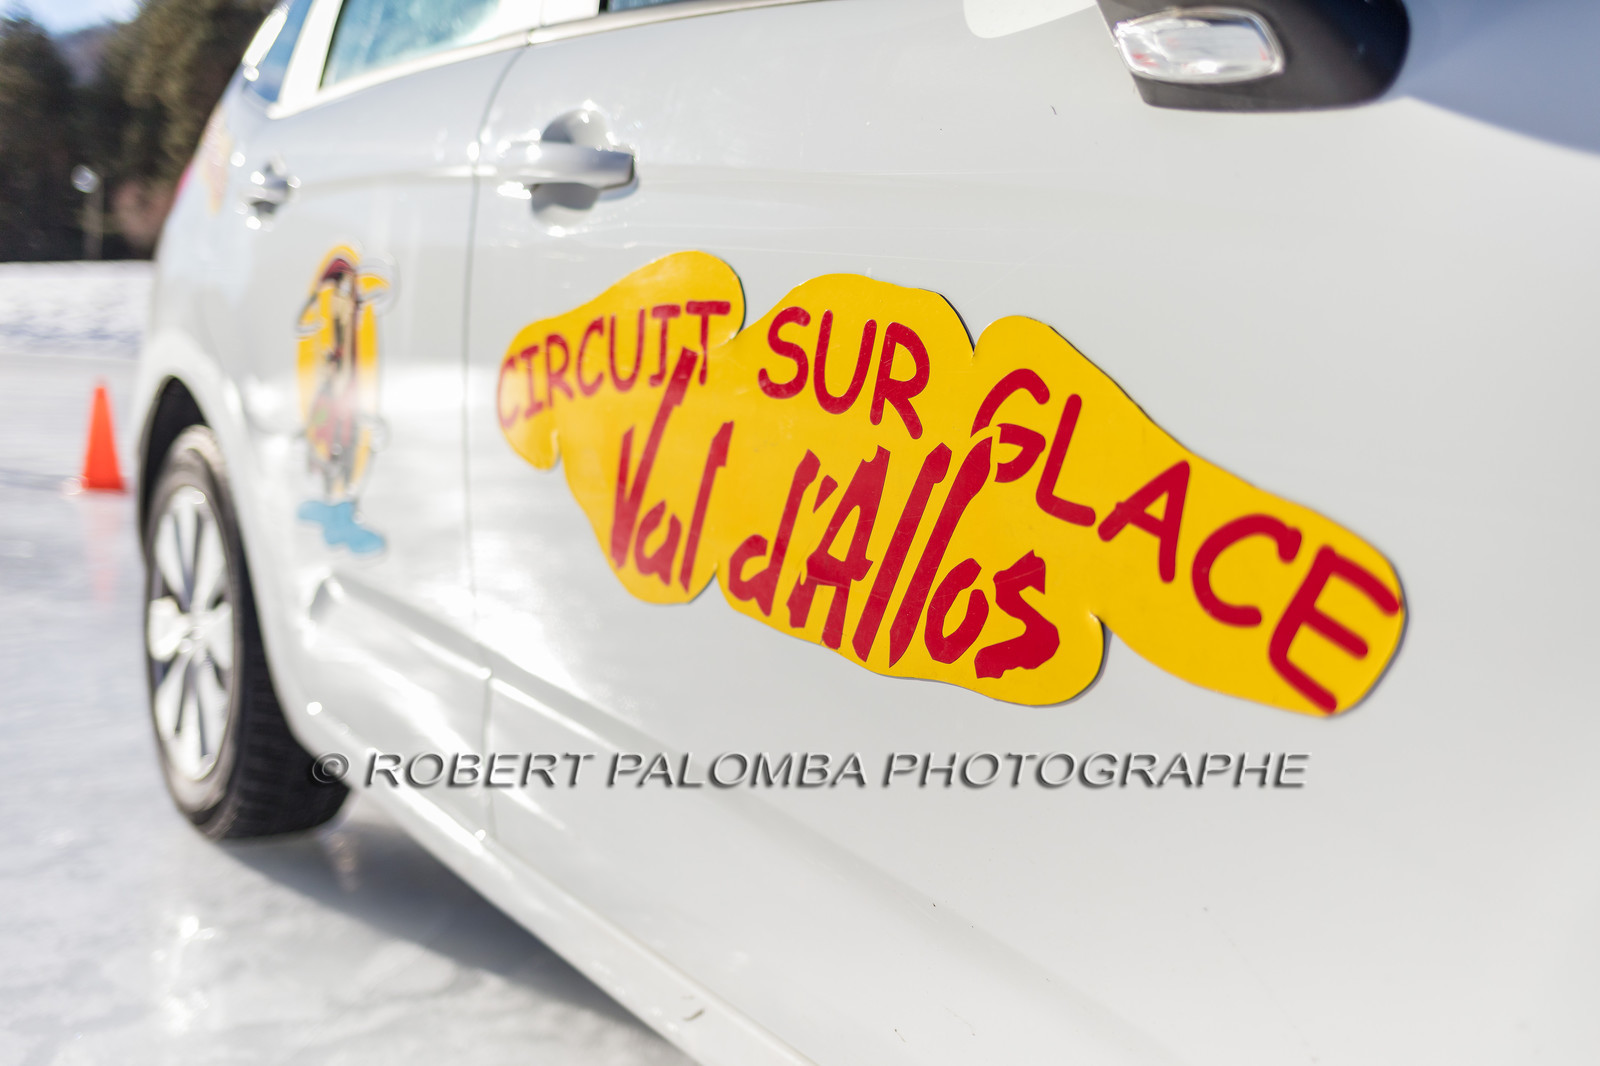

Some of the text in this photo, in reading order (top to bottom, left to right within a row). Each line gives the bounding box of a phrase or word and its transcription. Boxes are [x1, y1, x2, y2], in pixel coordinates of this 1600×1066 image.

[496, 300, 1405, 715] CIRCUIT SUR GLACE
[609, 346, 1061, 679] Val d'Allos
